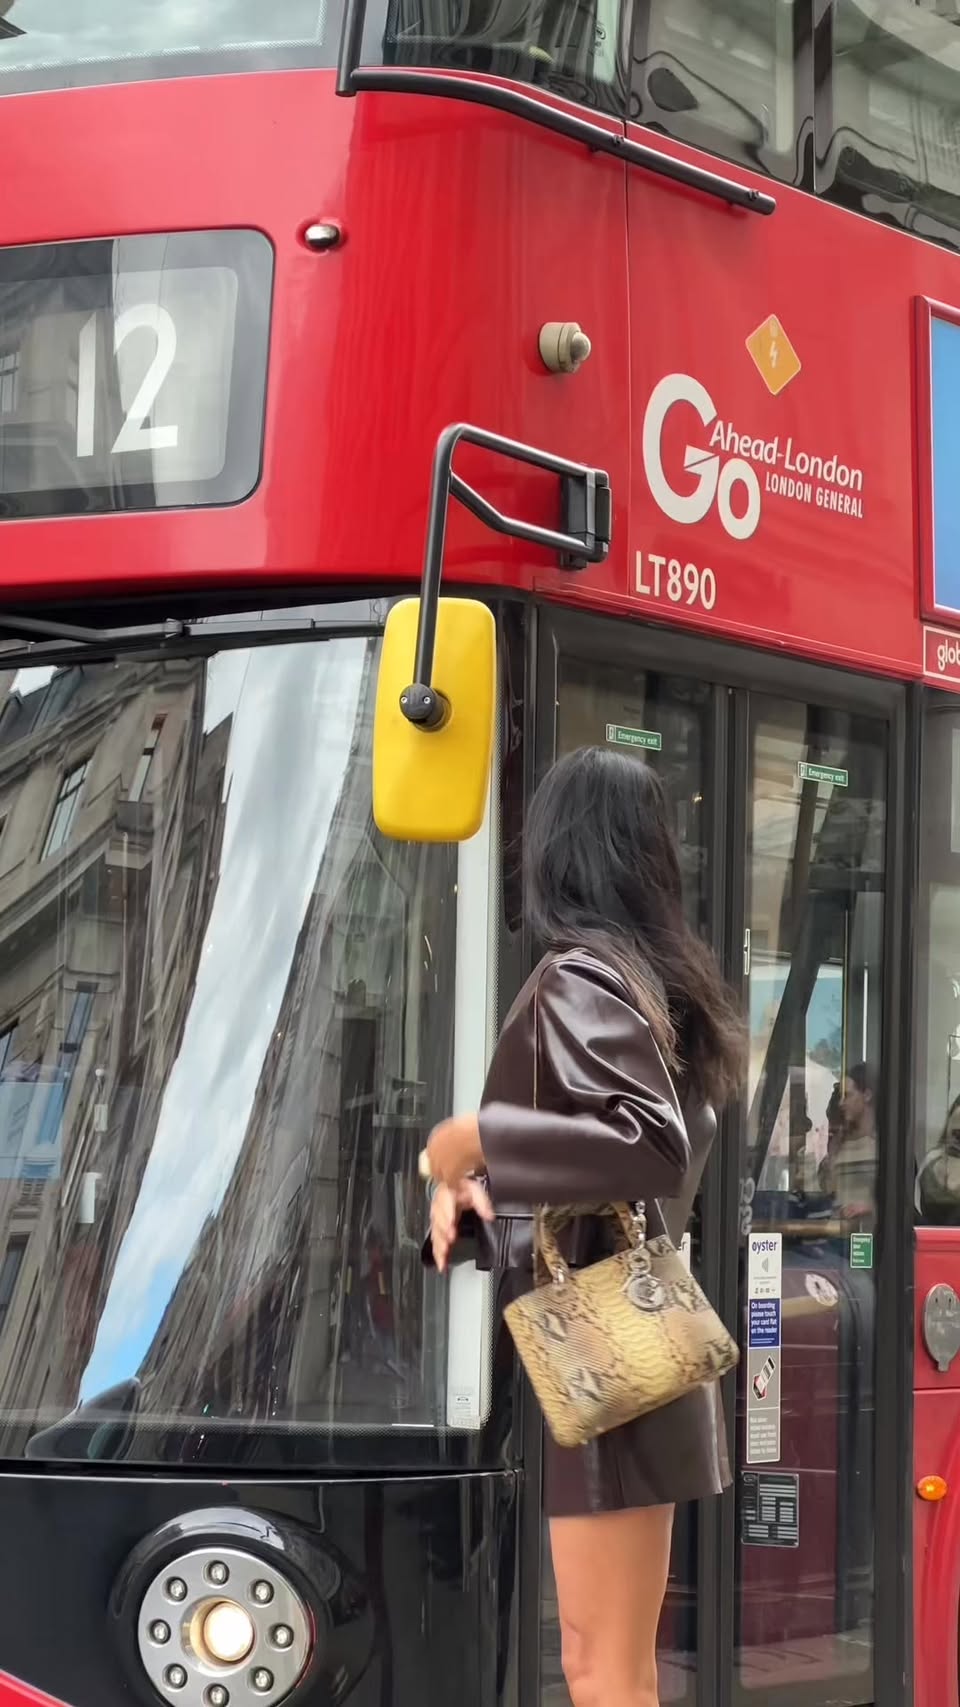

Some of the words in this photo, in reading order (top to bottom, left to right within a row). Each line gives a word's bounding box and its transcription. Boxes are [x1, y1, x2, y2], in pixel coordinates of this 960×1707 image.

[76, 303, 179, 458] 12
[642, 373, 761, 540] Go
[709, 420, 863, 492] Ahead-London
[765, 471, 812, 503] LONDON
[815, 486, 863, 519] GENERAL
[635, 550, 716, 610] LT890
[618, 730, 647, 745] Emergency
[647, 737, 658, 746] exit
[808, 768, 835, 782] Emergency
[835, 774, 844, 783] exit
[752, 1240, 777, 1255] oyster
